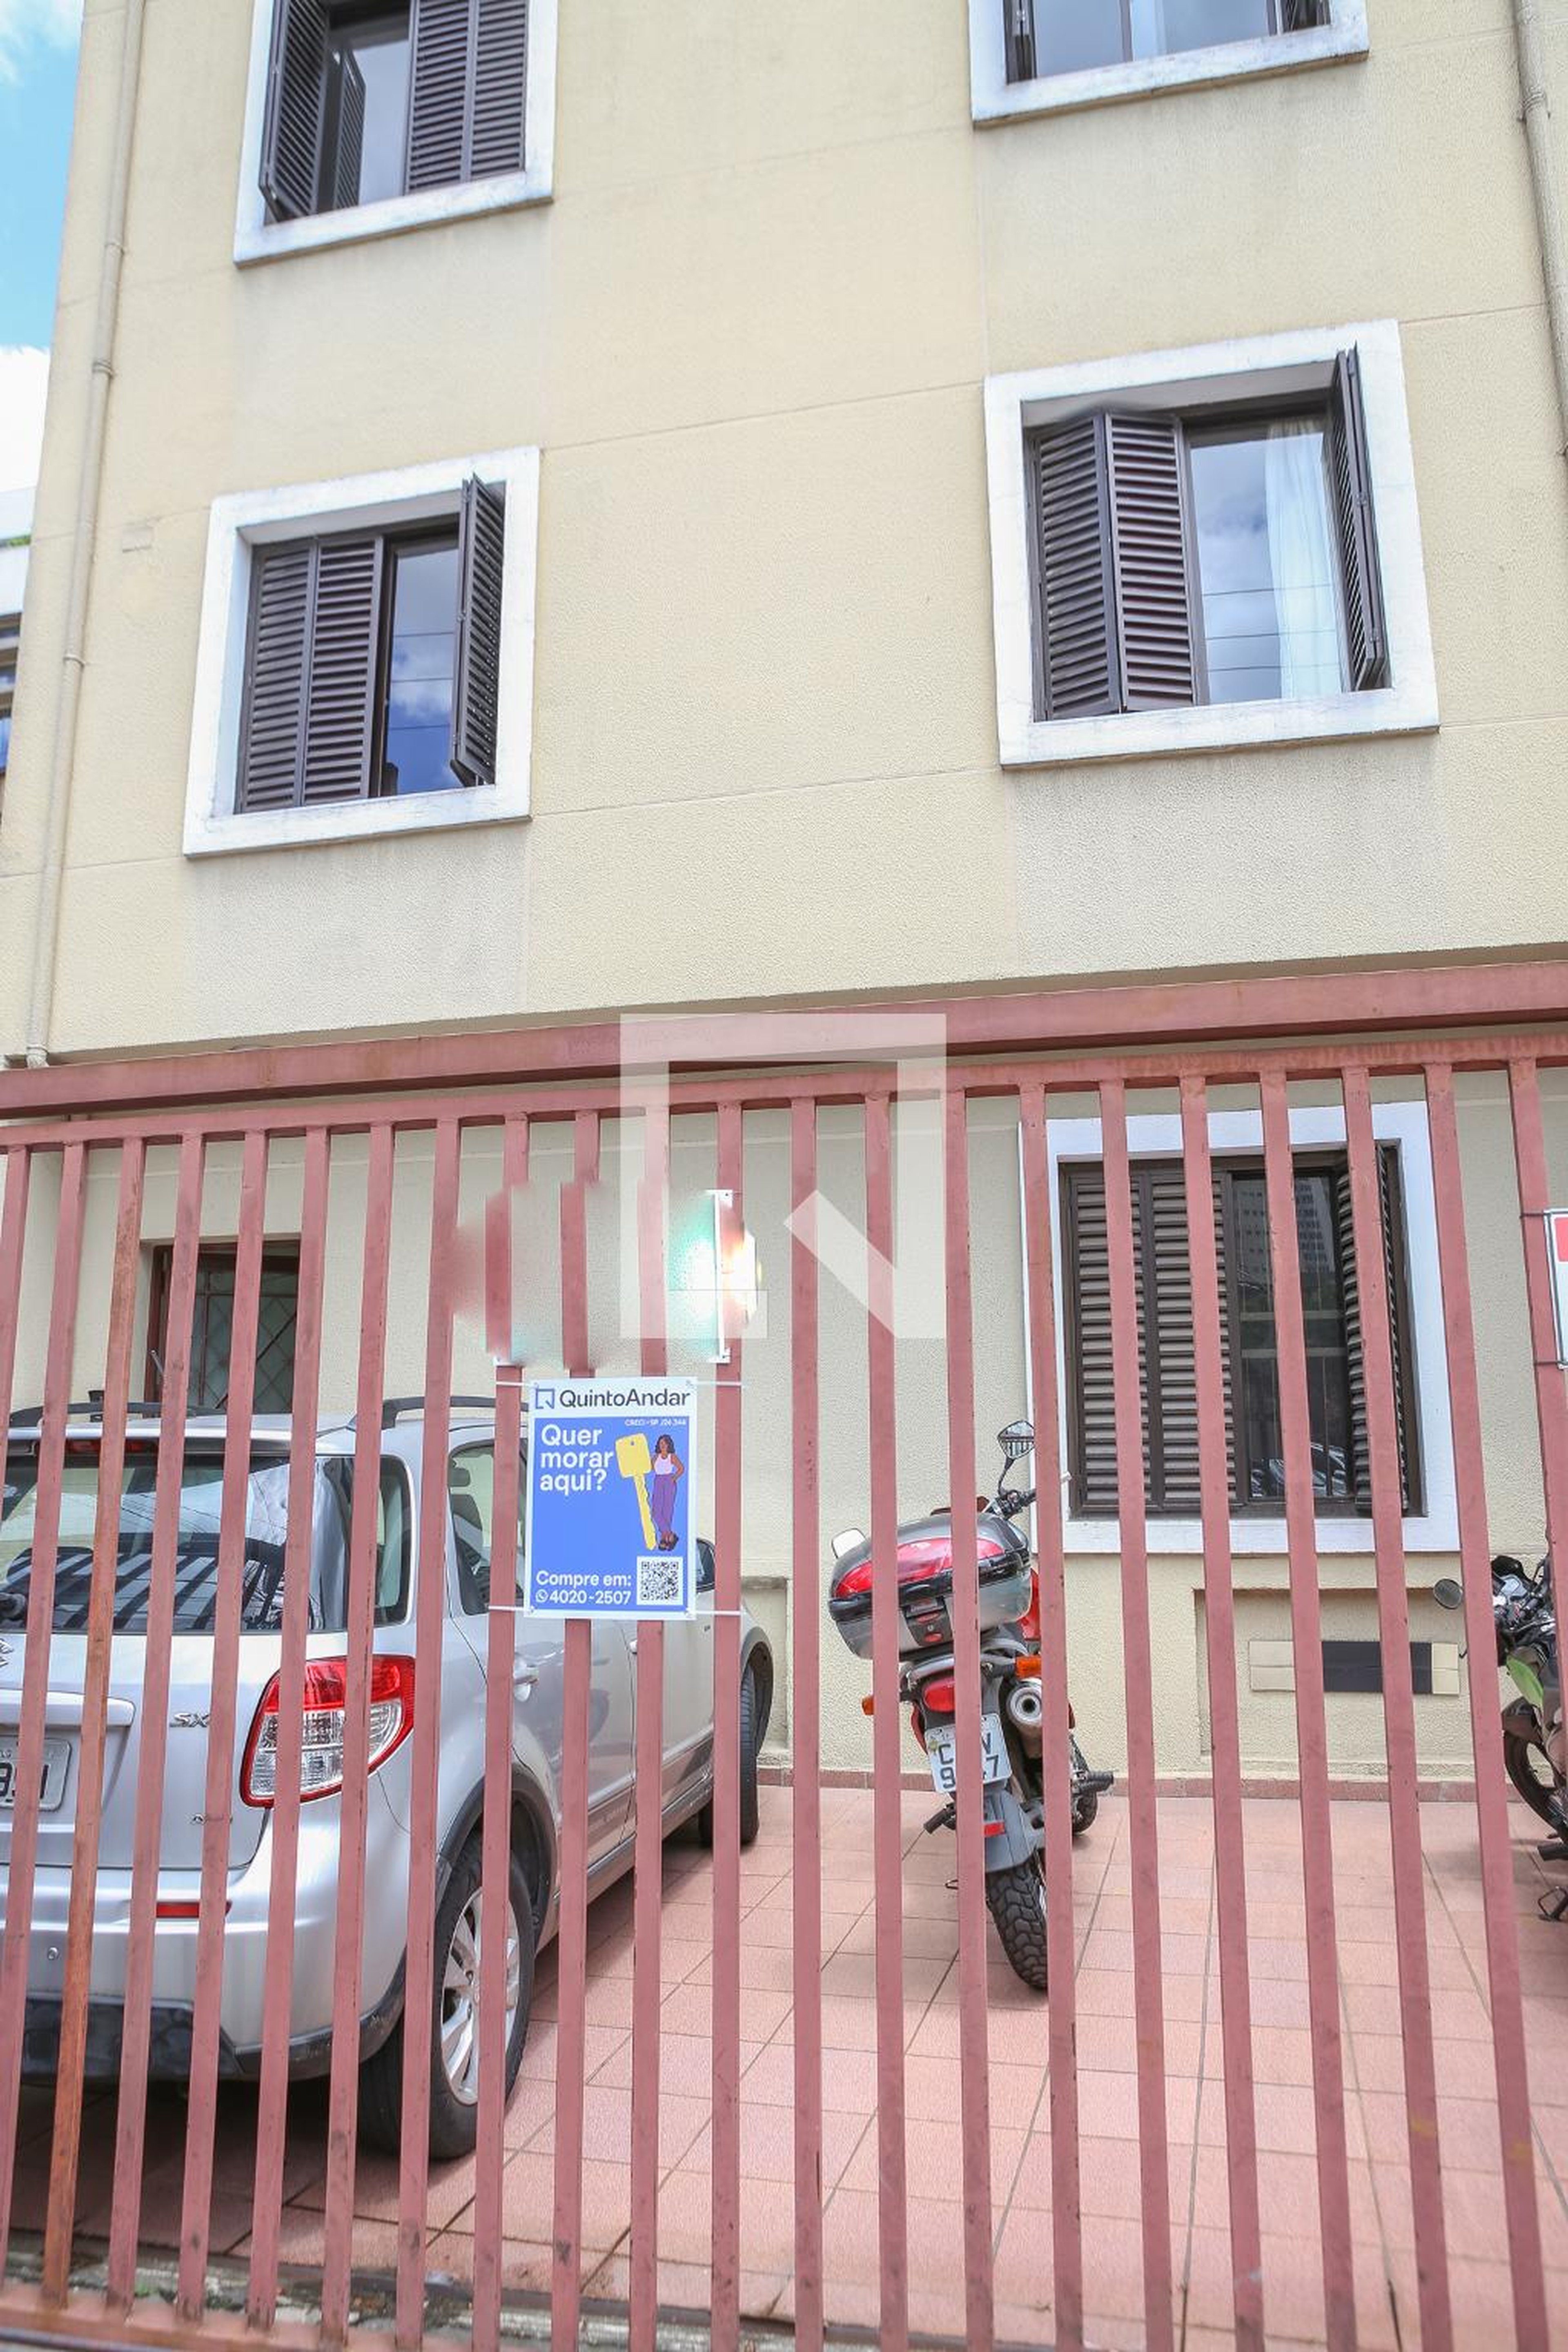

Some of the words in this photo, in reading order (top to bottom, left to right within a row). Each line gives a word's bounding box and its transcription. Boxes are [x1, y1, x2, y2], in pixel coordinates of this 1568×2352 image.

[560, 1388, 690, 1408] QuintoAndar
[541, 1424, 602, 1446] Quer
[541, 1451, 613, 1468] morar
[540, 1469, 607, 1495] aqui?
[536, 1570, 599, 1588] Compre
[603, 1574, 632, 1586] em:
[549, 1590, 631, 1604] 4020-2507
